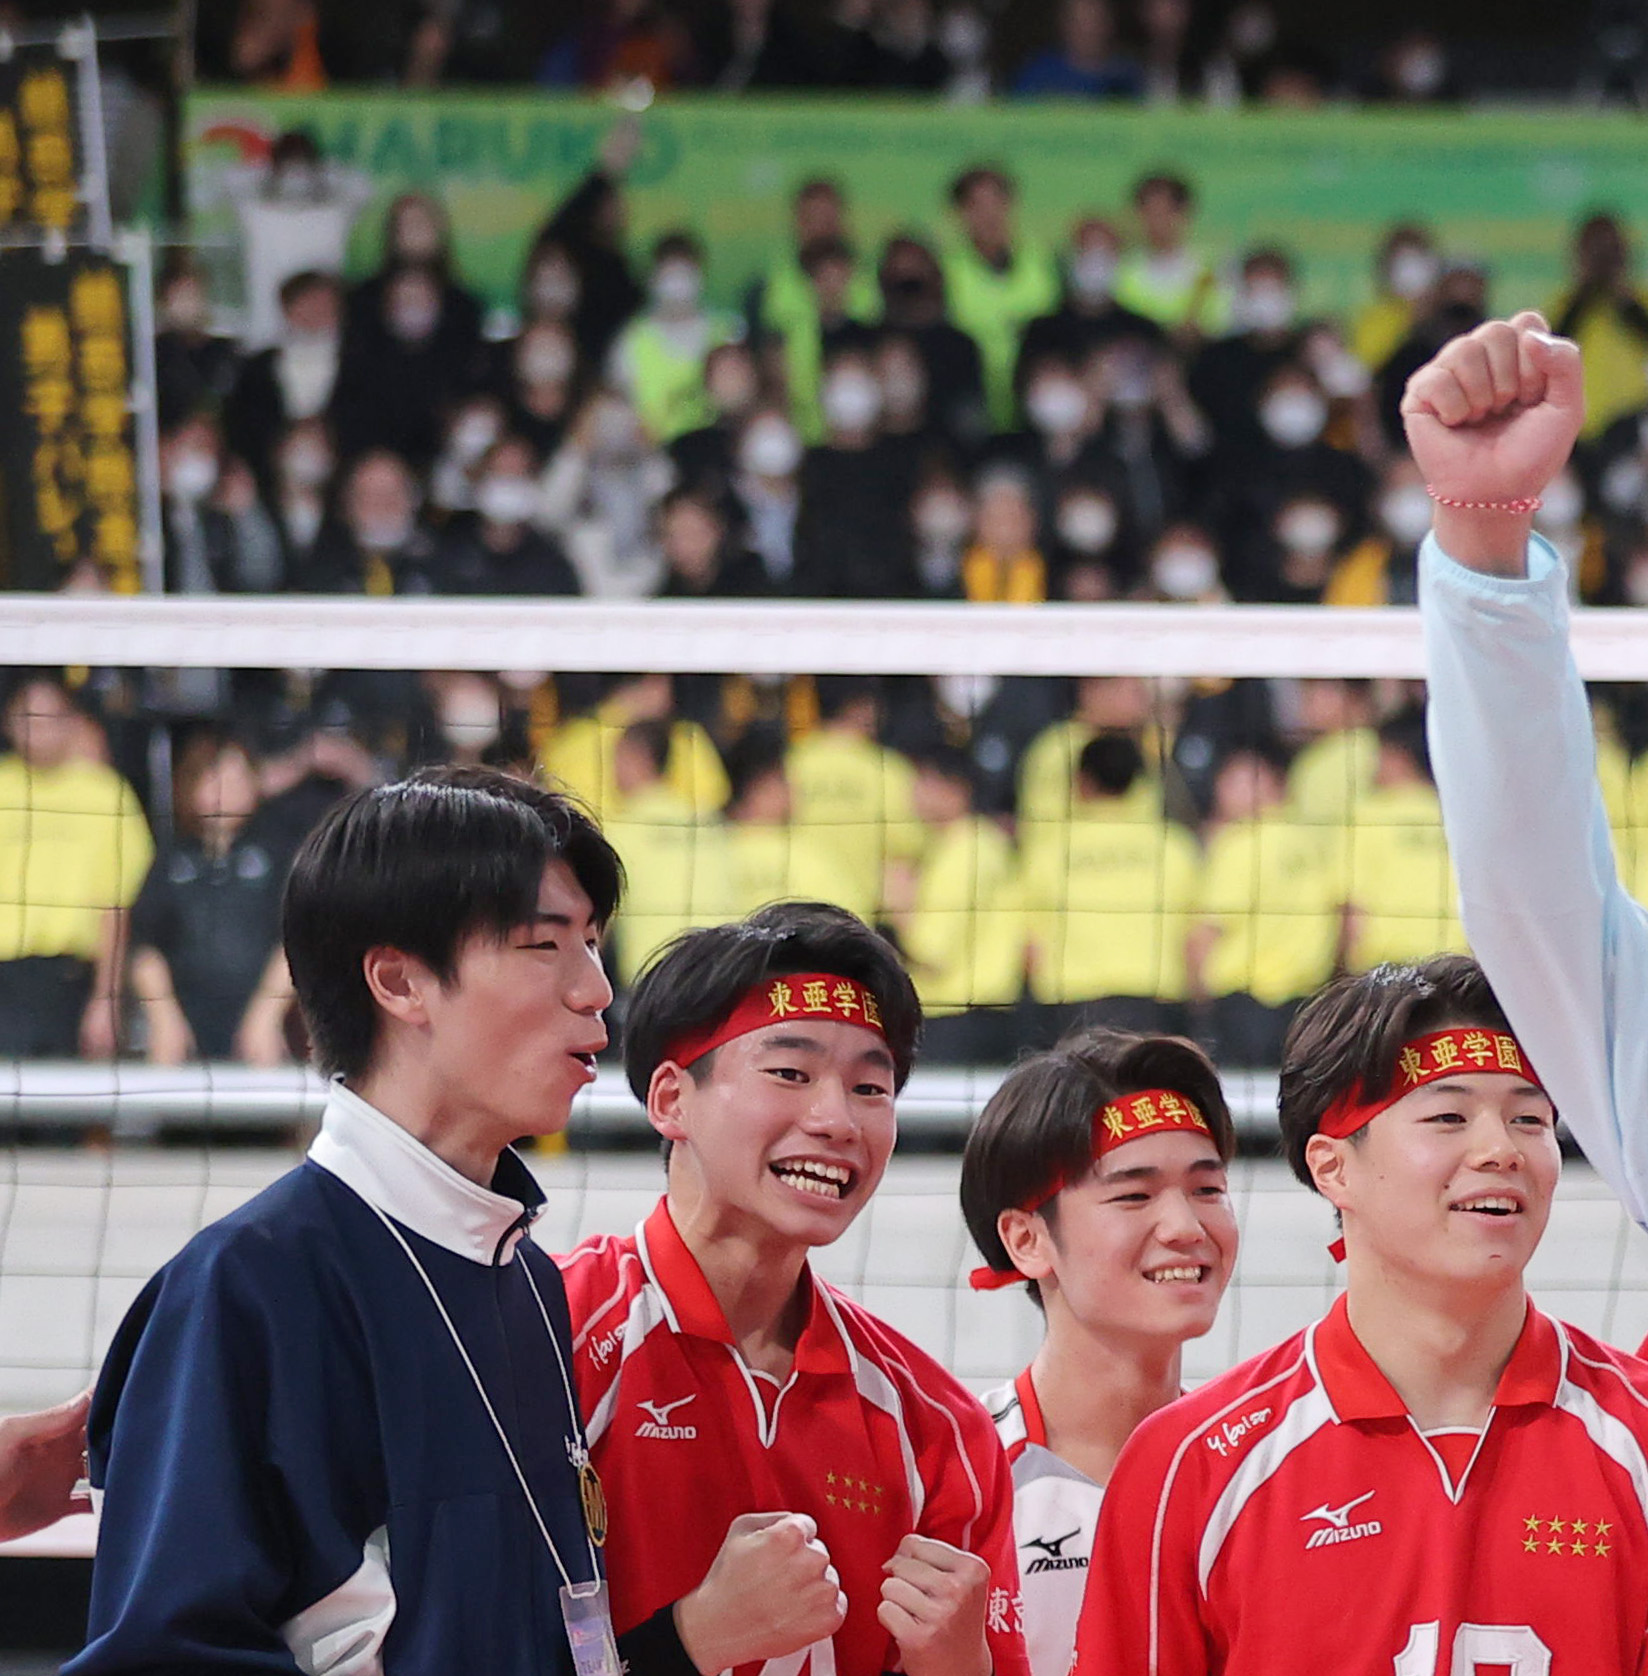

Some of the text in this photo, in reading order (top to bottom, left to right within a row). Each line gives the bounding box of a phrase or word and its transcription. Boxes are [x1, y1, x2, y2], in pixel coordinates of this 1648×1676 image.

[1399, 1032, 1523, 1088] 東亜学園
[634, 1421, 697, 1440] MIZUNO
[1305, 1521, 1382, 1550] MIZUNO
[1025, 1555, 1089, 1576] MIZUNO
